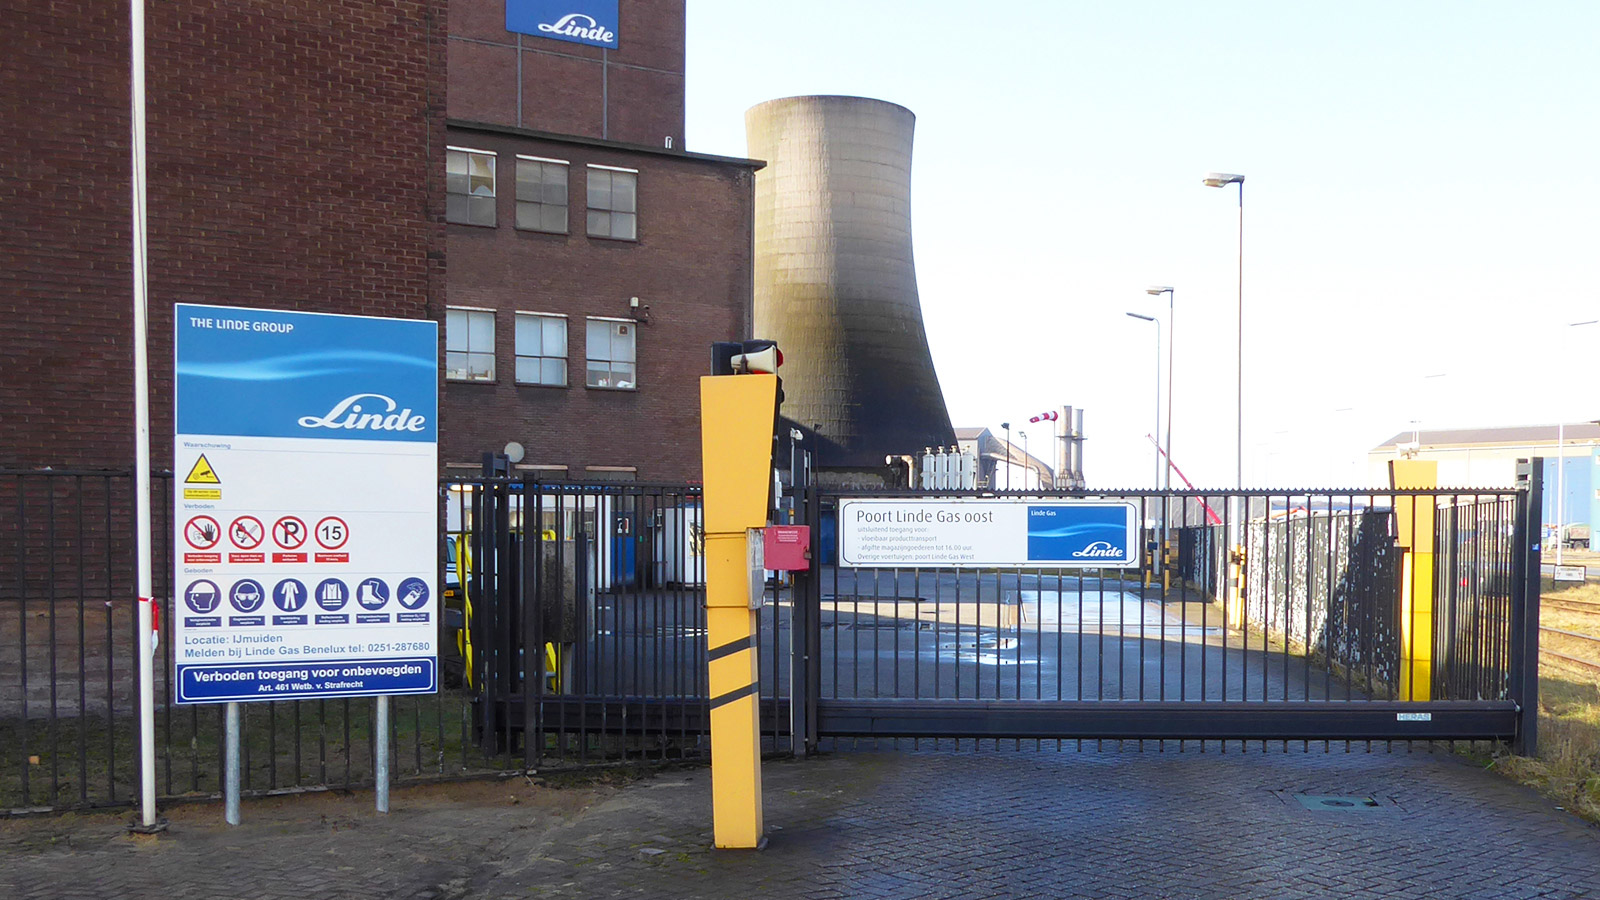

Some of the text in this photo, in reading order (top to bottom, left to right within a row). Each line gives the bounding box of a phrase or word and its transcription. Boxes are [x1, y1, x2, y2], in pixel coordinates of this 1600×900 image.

[538, 13, 614, 42] Linde
[190, 317, 294, 333] THE LINDE GROUP
[298, 393, 426, 432] Linde
[183, 441, 231, 450] Waarschuwing
[857, 509, 993, 523] Poort Linde Gas oost
[322, 525, 342, 541] 15
[889, 526, 913, 534] toegang
[857, 553, 880, 561] Overige
[1072, 541, 1124, 557] Linde
[184, 633, 283, 645] Locatie: IJmuiden
[184, 642, 430, 658] Melden bij Linde Gas Benelux tel: 0251-287680
[193, 664, 422, 682] Verboden toegang voor onbevoegden
[258, 684, 274, 692] Art.
[291, 682, 315, 691] Wetb.
[324, 680, 364, 689] Strafrecht
